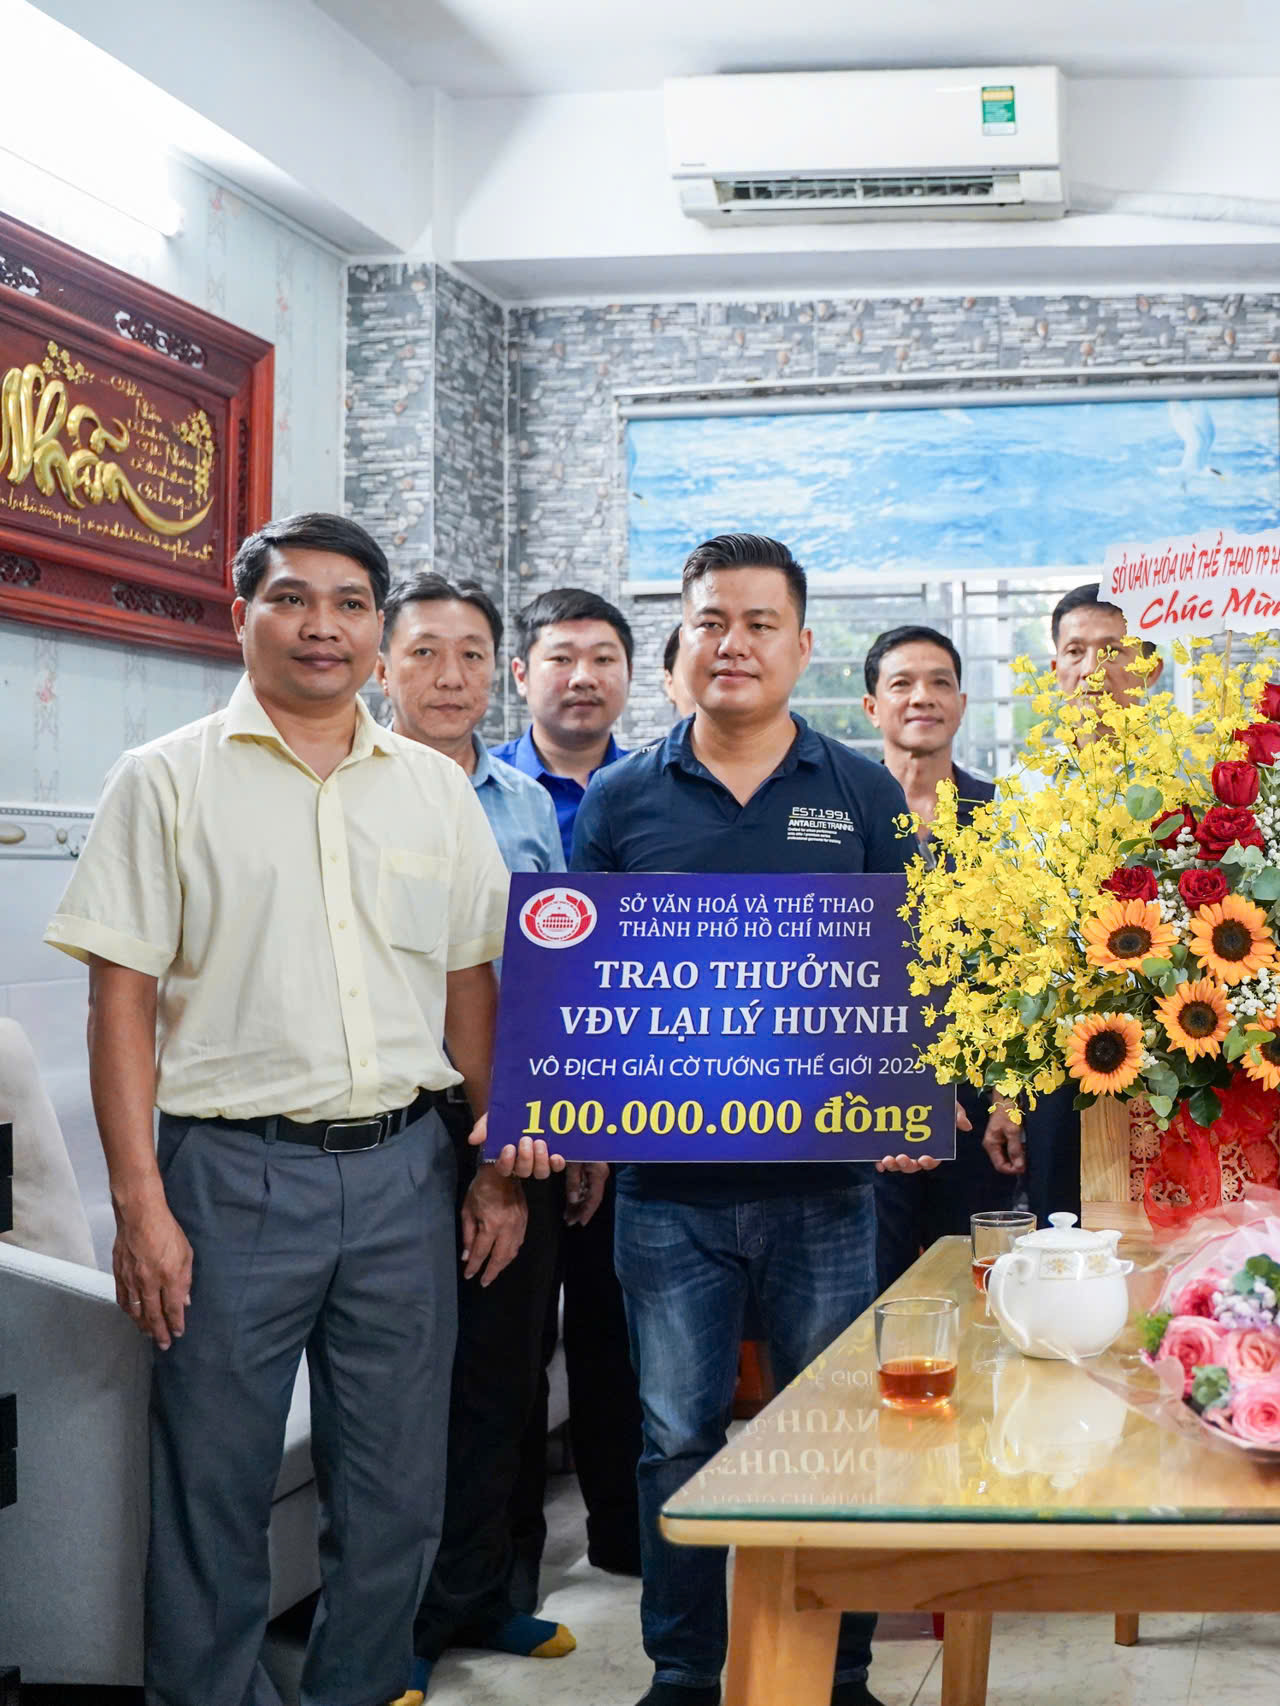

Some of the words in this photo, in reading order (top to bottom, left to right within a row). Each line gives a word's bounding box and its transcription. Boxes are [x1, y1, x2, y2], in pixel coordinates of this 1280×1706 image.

[1111, 553, 1127, 594] SỞ
[1128, 555, 1153, 590] VĂN
[1152, 547, 1178, 588] HÓA
[1180, 544, 1196, 581] VÀ
[1197, 531, 1222, 580] THỂ
[1222, 546, 1255, 577] THAO
[1256, 545, 1270, 577] TP
[1140, 589, 1213, 630] Chúc
[788, 819, 809, 828] ANTA
[792, 806, 851, 821] EST.1991
[619, 893, 647, 913] SỞ
[652, 893, 691, 913] VĂN
[697, 893, 739, 913] HOÁ
[745, 894, 769, 913] VÀ
[774, 893, 815, 913] THỂ
[819, 897, 875, 913] THAO
[619, 917, 690, 937] THÀNH
[696, 917, 738, 937] PHỐ
[744, 917, 772, 937] HỒ
[778, 917, 812, 937] CHÍ
[817, 921, 872, 937] MINH
[594, 960, 699, 989] TRAO
[709, 953, 881, 989] THƯỞNG
[560, 1006, 640, 1035] VĐV
[648, 1006, 712, 1043] LẠI
[720, 999, 763, 1036] LÝ
[772, 1005, 909, 1035] HUYNH
[529, 1055, 560, 1076] VÔ
[564, 1057, 616, 1080] ĐỊCH
[622, 1054, 664, 1076] GIẢI
[669, 1055, 700, 1076] CỜ
[704, 1055, 780, 1076] TƯỚNG
[785, 1053, 824, 1075] THẾ
[829, 1054, 872, 1075] GIỚI
[522, 1100, 803, 1135] 100.000.000
[814, 1091, 933, 1143] đồng
